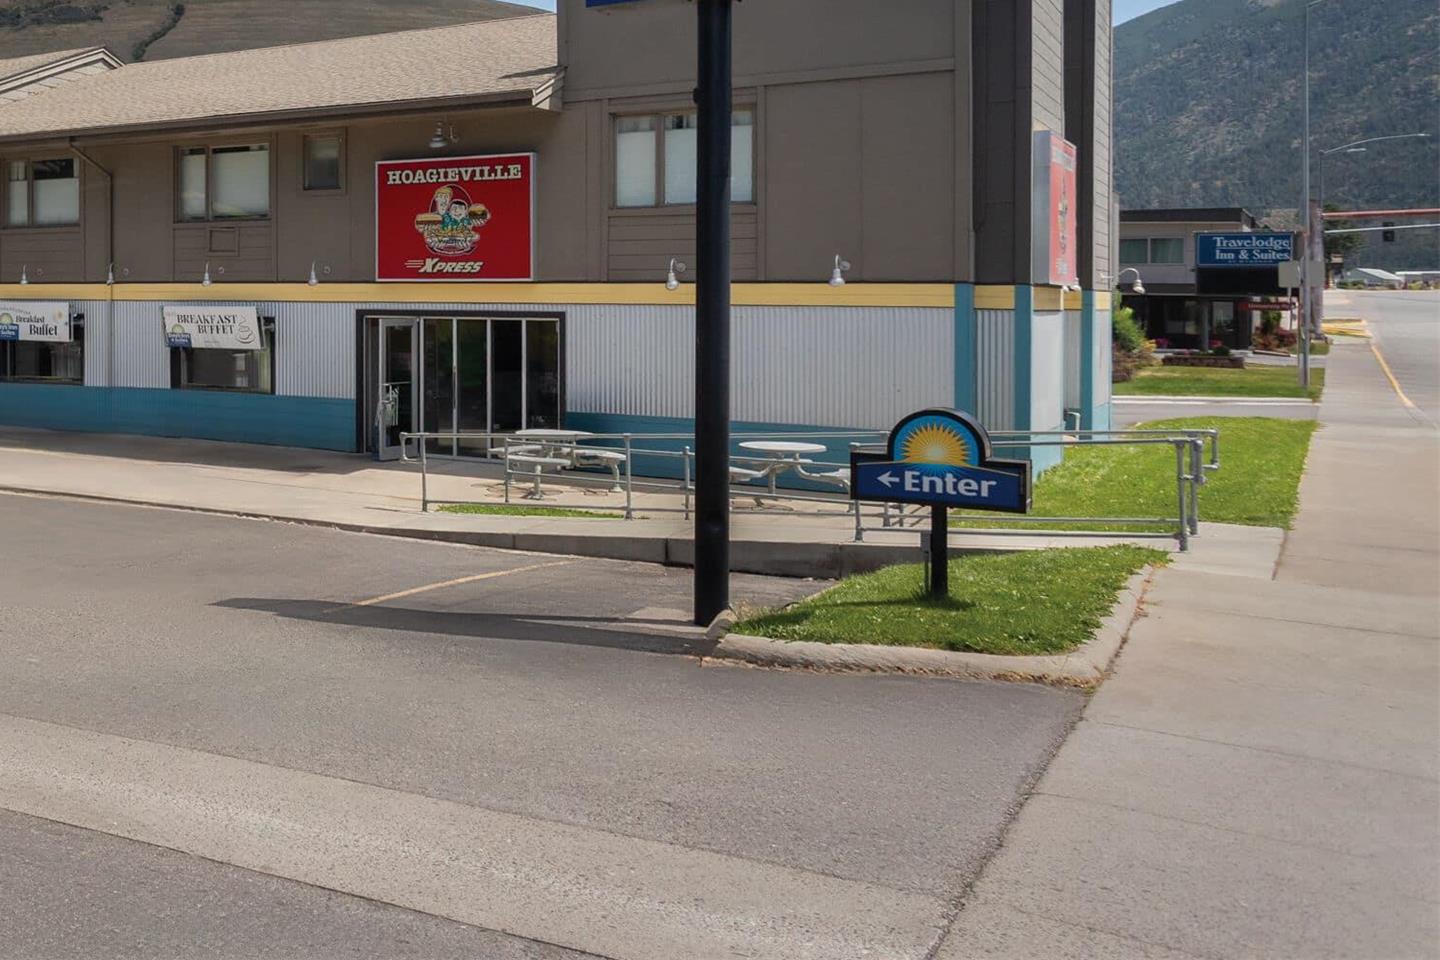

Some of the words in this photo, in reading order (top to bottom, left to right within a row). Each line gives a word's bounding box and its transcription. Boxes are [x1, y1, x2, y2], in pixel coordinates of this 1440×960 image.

[386, 164, 522, 185] HOAGIEVILLE
[1213, 237, 1291, 250] Travelodge
[1215, 249, 1235, 260] Inn
[1239, 249, 1249, 260] &
[1252, 248, 1290, 260] Suites
[15, 315, 45, 323] Breakfast
[176, 314, 238, 324] BREAKFAST
[29, 324, 58, 336] Buffet
[197, 324, 234, 334] BUFFET
[904, 470, 997, 498] Enter
